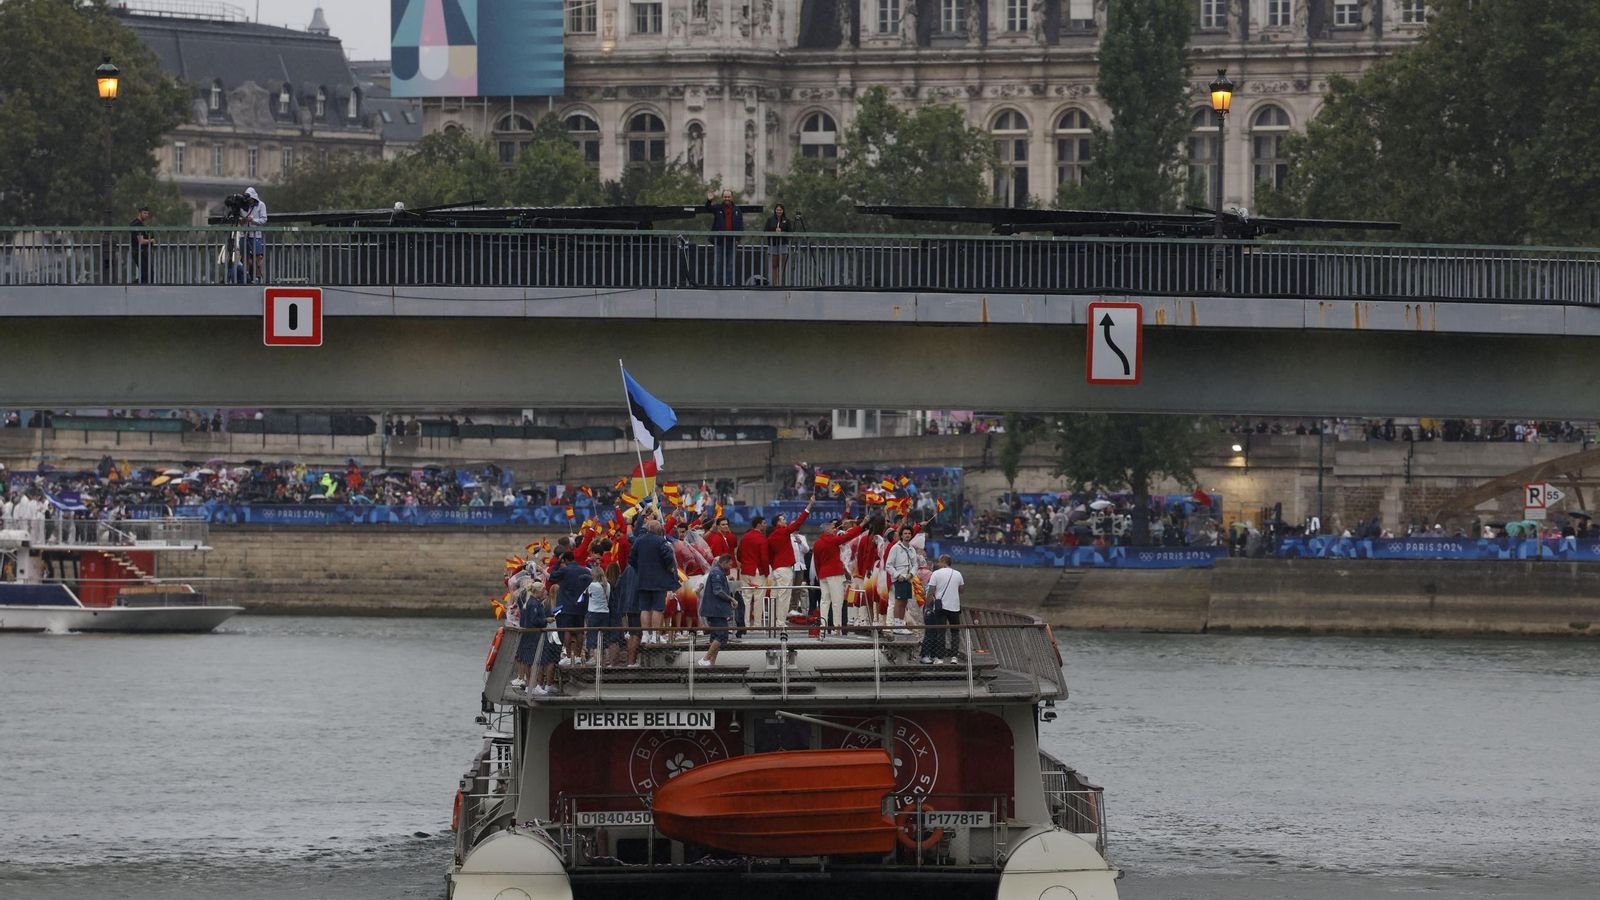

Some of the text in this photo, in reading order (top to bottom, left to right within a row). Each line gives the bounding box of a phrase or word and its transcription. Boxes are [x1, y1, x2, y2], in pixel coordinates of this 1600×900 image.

[1546, 491, 1559, 500] 55
[277, 509, 325, 519] PARIS 2024
[445, 510, 493, 519] PARIS 2024
[820, 511, 842, 520] 2024
[1406, 542, 1463, 552] PARIS 2024
[968, 547, 1022, 558] PARIS 2024
[1156, 551, 1211, 560] PARIS 2024
[577, 712, 712, 727] PIERRE BELLON
[928, 813, 984, 825] P17781F
